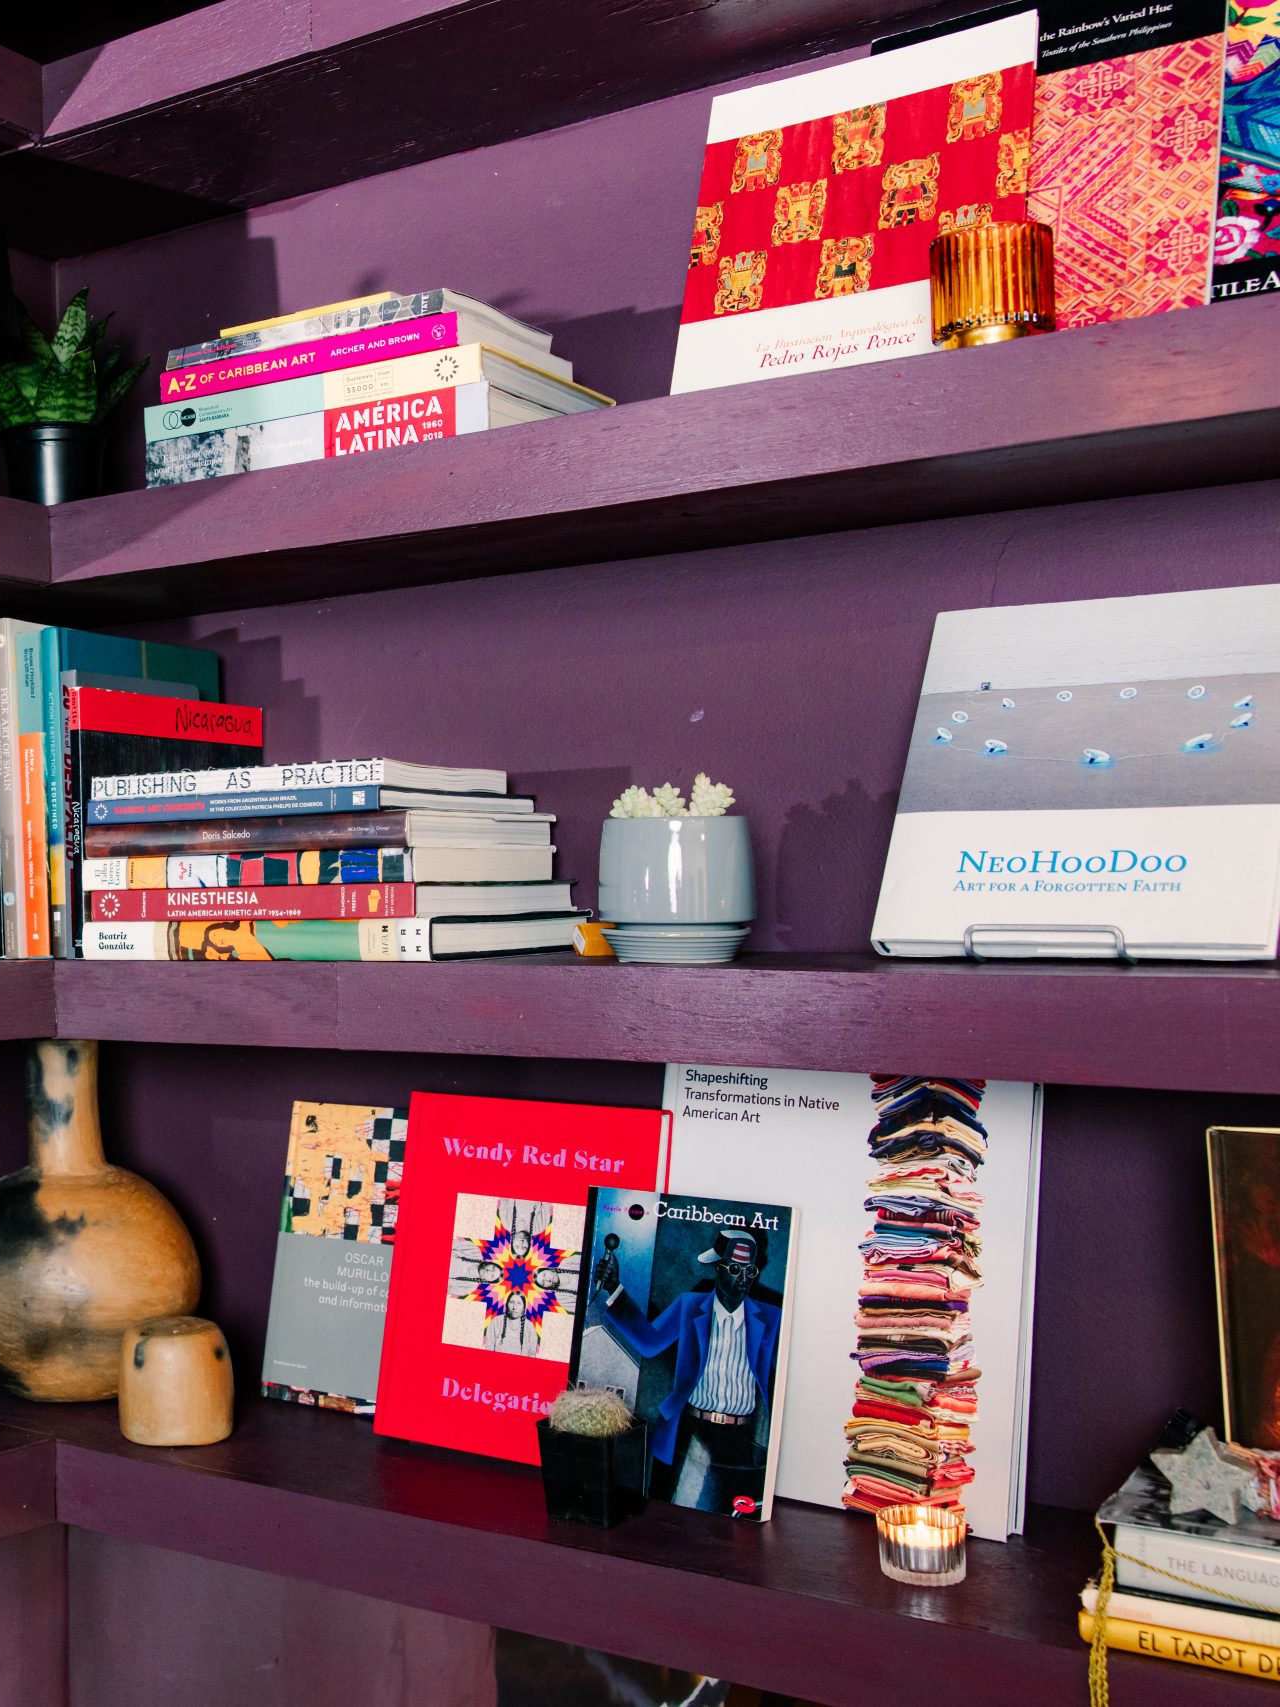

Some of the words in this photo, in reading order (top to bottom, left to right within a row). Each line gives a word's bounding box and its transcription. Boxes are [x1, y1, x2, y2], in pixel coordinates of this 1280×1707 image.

[1039, 31, 1056, 42] the
[1058, 17, 1111, 38] Rainbow's
[1112, 10, 1146, 24] Varied
[1148, 3, 1174, 16] Hue
[1041, 46, 1068, 58] Textiles
[1092, 31, 1127, 47] Southern
[421, 293, 431, 317] TATE
[330, 344, 367, 358] ARCHER
[367, 338, 387, 350] AND
[387, 332, 421, 346] BROWN
[759, 349, 805, 369] Pedro
[812, 342, 860, 363] Rojas
[866, 331, 917, 351] Ponce
[166, 372, 197, 396] A-Z
[199, 371, 214, 385] OF
[217, 358, 288, 381] CARIBBEAN
[290, 350, 317, 367] ART
[334, 395, 444, 433] AMÉRICA
[421, 418, 444, 430] 1960
[334, 424, 420, 456] LATINA
[1, 718, 10, 740] ART
[2, 742, 11, 757] OF
[3, 759, 12, 791] SPAIN
[92, 774, 197, 798] PUBLISHING
[225, 770, 251, 790] AS
[282, 763, 382, 786] PRACTICE
[203, 831, 221, 841] Doris
[222, 829, 251, 840] Salcedo
[167, 891, 259, 906] KINESTHESIA
[187, 909, 223, 917] AMERICAN
[224, 909, 253, 917] KINETIC
[98, 932, 128, 941] Beatriz
[98, 941, 135, 951] González
[685, 1069, 769, 1091] Shapeshifting
[684, 1086, 781, 1107] Transformations
[784, 1094, 795, 1108] in
[799, 1095, 840, 1111] Native
[682, 1105, 738, 1122] American
[740, 1109, 761, 1124] Art
[442, 1135, 517, 1168] Wendy
[521, 1144, 569, 1169] Red
[573, 1148, 626, 1175] Star
[653, 1200, 747, 1227] Caribbean
[749, 1211, 779, 1231] Art
[344, 1252, 384, 1267] OSCAR
[337, 1265, 389, 1283] MURILLO
[304, 1276, 320, 1289] the
[322, 1278, 364, 1297] build-up
[366, 1286, 379, 1296] of
[318, 1295, 338, 1306] and
[1166, 1556, 1198, 1574] THE
[1138, 1629, 1163, 1653] EL
[1171, 1636, 1247, 1665] TAROT
